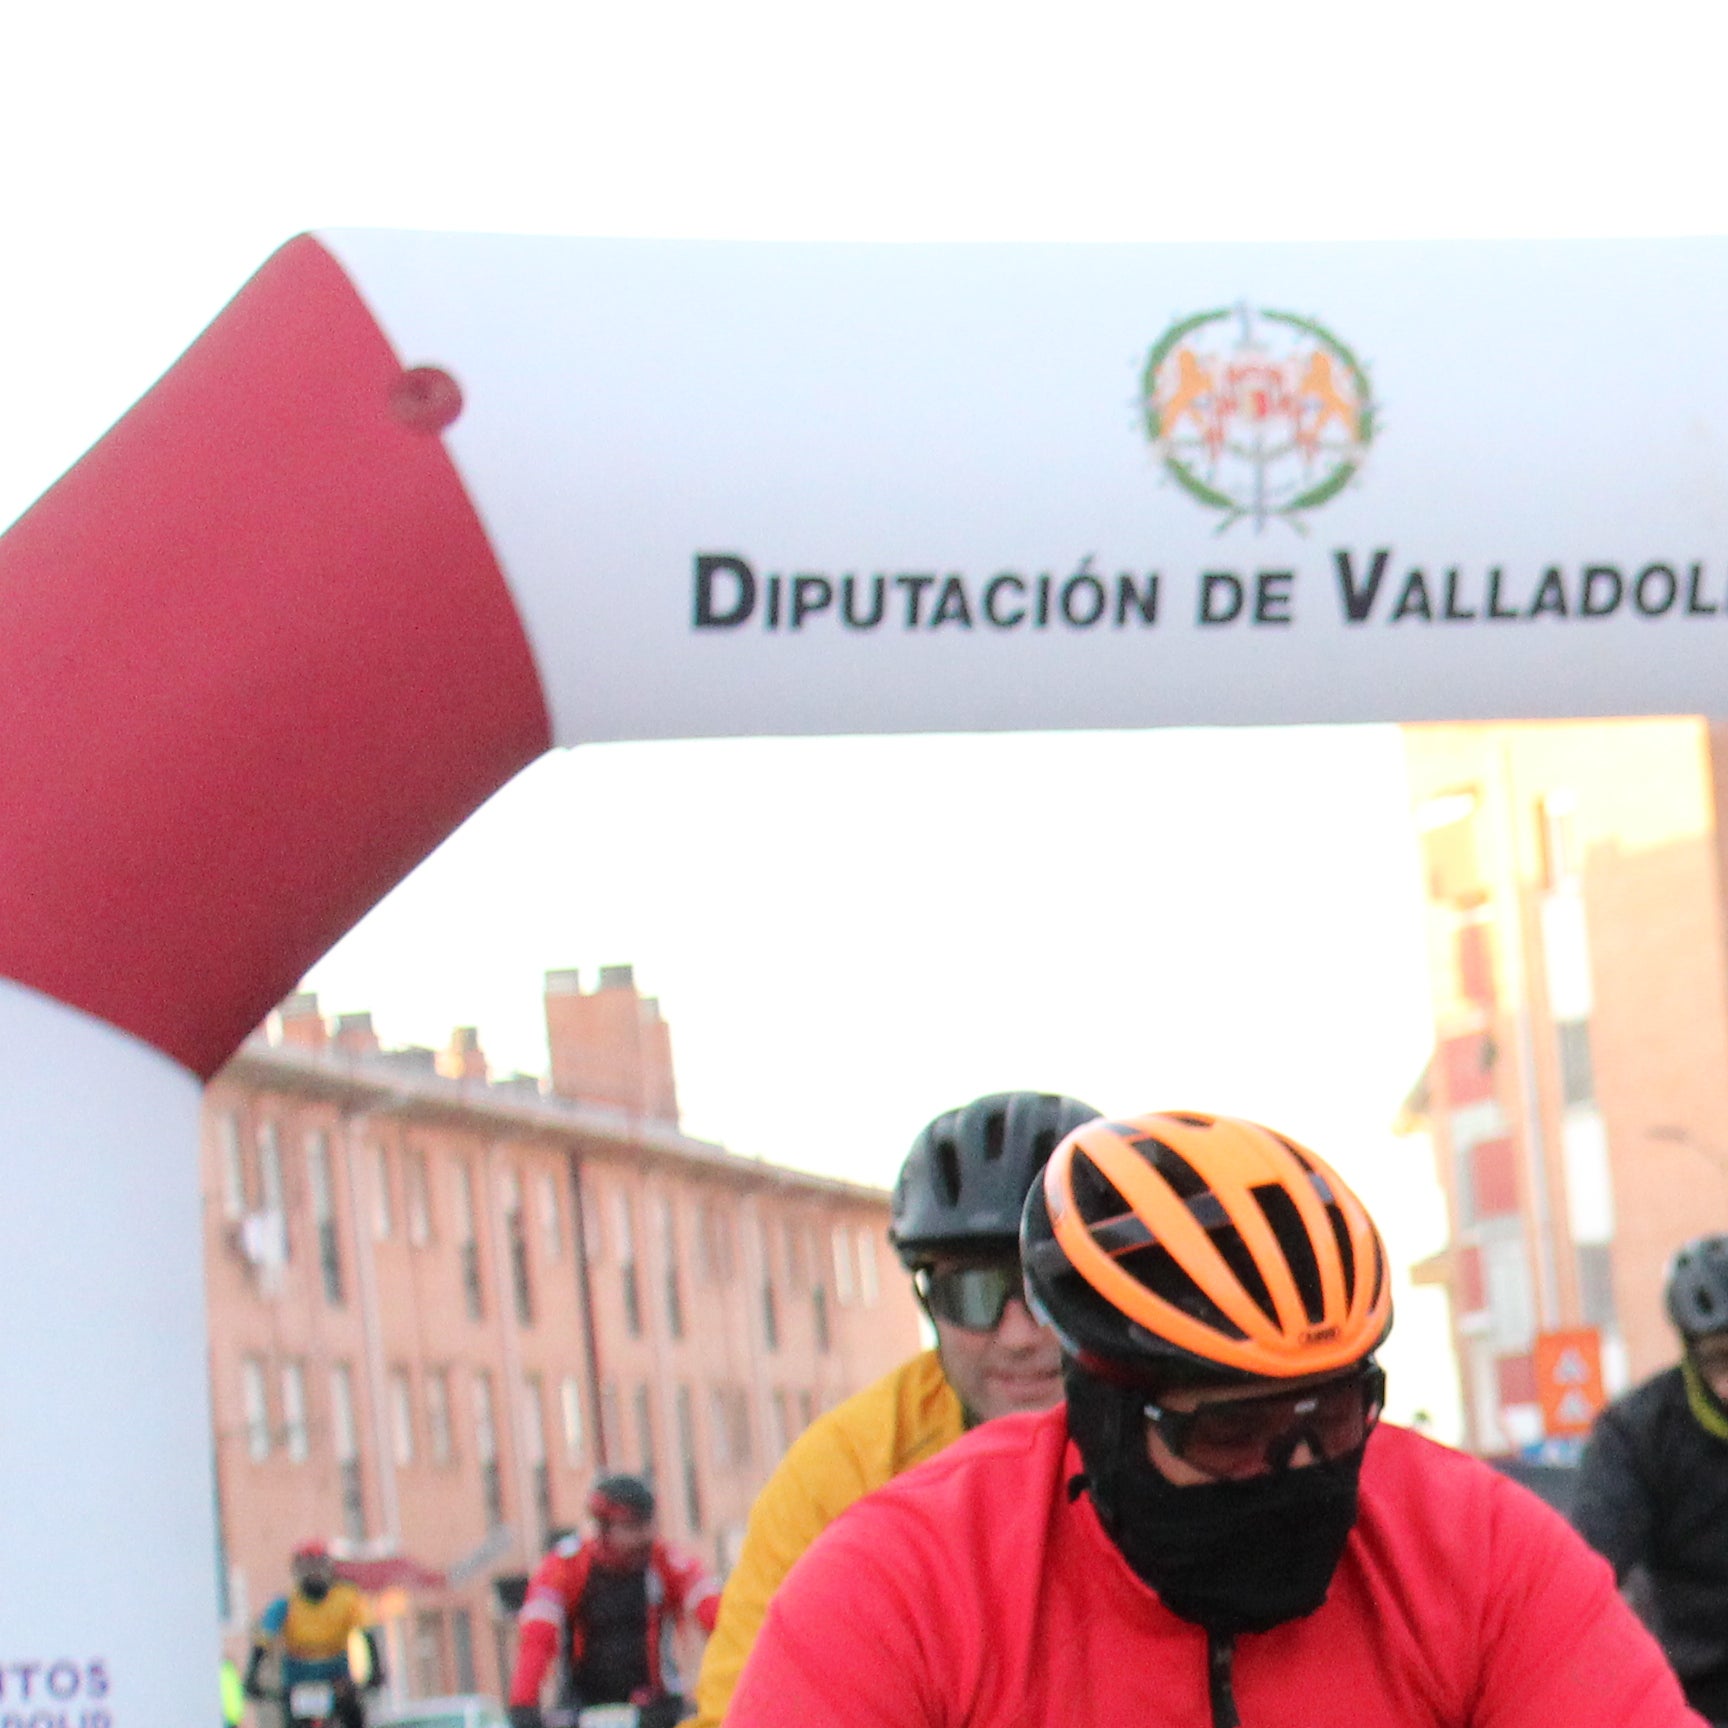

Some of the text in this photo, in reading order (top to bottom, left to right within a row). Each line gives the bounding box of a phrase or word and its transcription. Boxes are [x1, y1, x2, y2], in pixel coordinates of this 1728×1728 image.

[690, 549, 1160, 631] DIPUTACIÓN
[1198, 570, 1296, 627] DE
[0, 1661, 110, 1702] TOS
